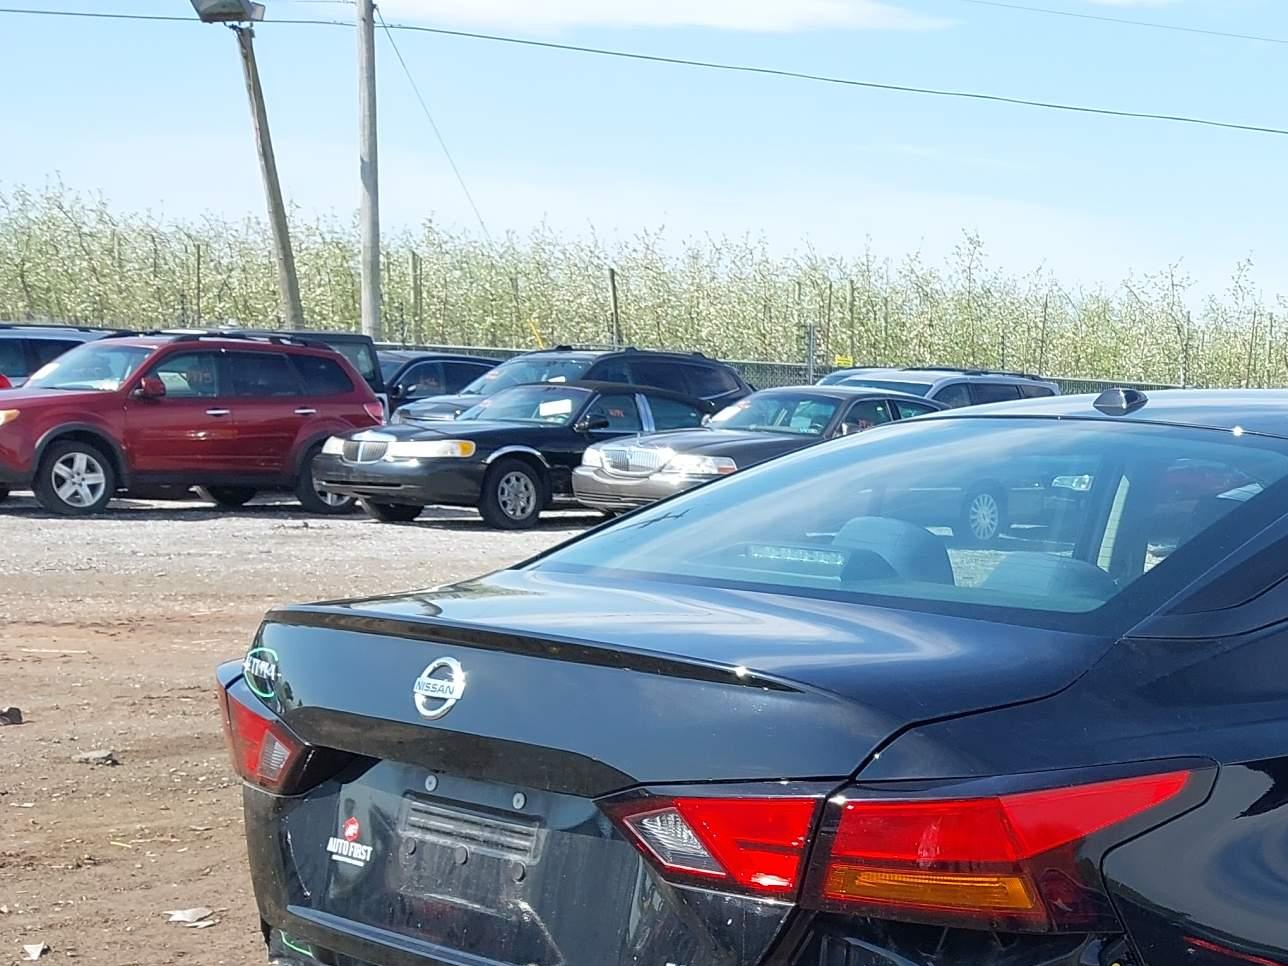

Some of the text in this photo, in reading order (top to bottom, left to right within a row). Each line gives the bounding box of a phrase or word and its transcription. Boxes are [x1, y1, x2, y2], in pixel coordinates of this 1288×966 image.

[415, 679, 455, 695] NISSAN
[326, 837, 349, 855] AUTO
[348, 841, 373, 862] FIRST
